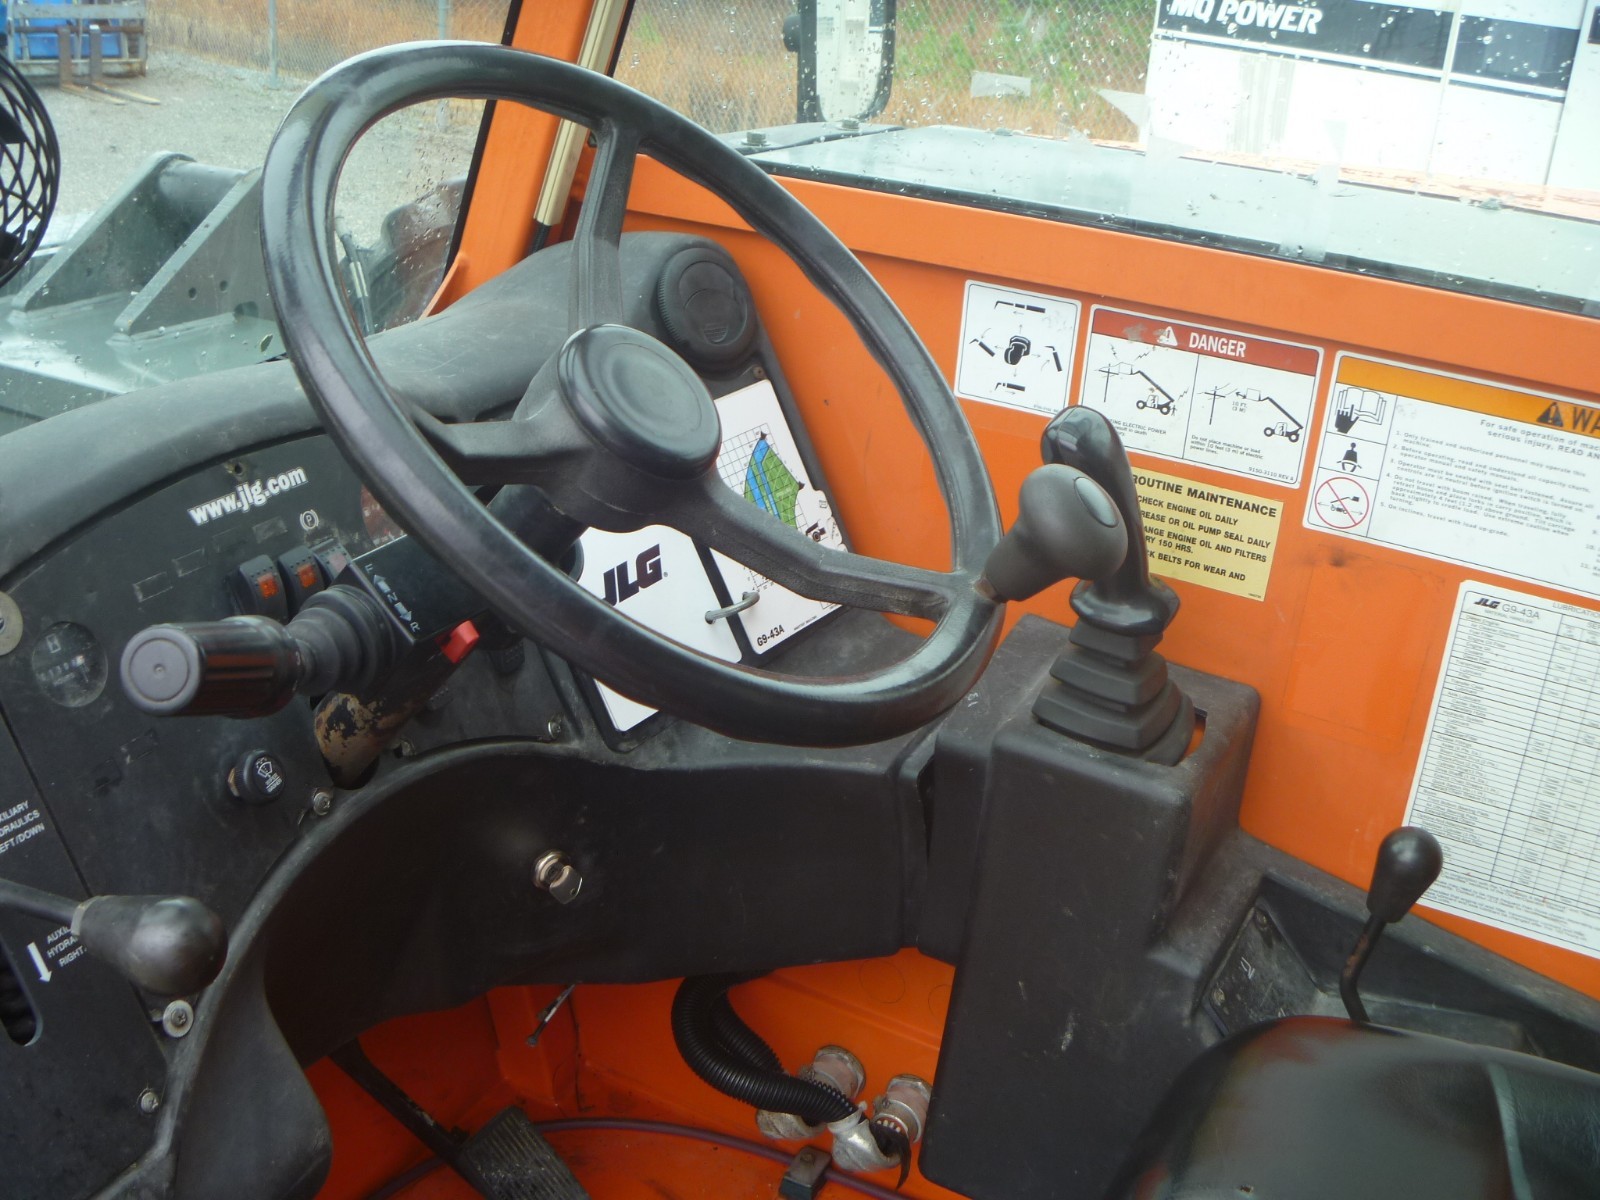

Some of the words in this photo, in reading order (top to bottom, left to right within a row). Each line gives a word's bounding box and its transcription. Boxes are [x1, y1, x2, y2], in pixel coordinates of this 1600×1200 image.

[1168, 0, 1214, 23] MQ
[1216, 0, 1323, 34] POWER
[1189, 332, 1246, 357] DANGER
[1123, 422, 1146, 430] ELECTRIC
[1480, 419, 1495, 428] For
[1499, 424, 1518, 433] safe
[1520, 428, 1565, 443] operation
[1568, 437, 1579, 445] of
[1487, 431, 1521, 442] serious
[1524, 437, 1554, 450] injury.
[1558, 445, 1584, 456] READ
[1586, 451, 1600, 459] AN
[188, 467, 308, 526] www.jlg.com
[1132, 475, 1182, 494] ROUTINE
[1187, 488, 1277, 517] MAINTENANCE
[1138, 495, 1164, 508] CHECK
[1167, 503, 1197, 515] ENGINE
[1200, 510, 1212, 519] OIL
[1215, 514, 1238, 526] DAILY
[1141, 511, 1166, 523] REASE
[1169, 517, 1180, 526] OR
[1183, 521, 1195, 530] OIL
[1199, 525, 1222, 535] PUMP
[1224, 531, 1244, 542] SEAL
[1248, 537, 1270, 549] DAILY
[1144, 526, 1165, 537] ANGE
[1167, 532, 1197, 544] ENGINE
[1200, 540, 1212, 549] OIL
[1215, 544, 1232, 554] AND
[1234, 549, 1267, 563] FILTERS
[1159, 539, 1172, 548] 150
[1175, 543, 1193, 554] HRS.
[601, 544, 662, 606] JLG
[1158, 553, 1182, 565] BELTS
[1184, 559, 1200, 570] FOR
[1203, 565, 1227, 577] WEAR
[1229, 571, 1246, 581] AND
[364, 563, 374, 574] F
[410, 621, 421, 633] R
[1474, 598, 1500, 609] JLG
[1502, 604, 1540, 619] G9-43A
[757, 624, 784, 646] G9-43A
[0, 801, 28, 822] XILIARY
[0, 810, 40, 837] DRAULICS
[0, 823, 45, 853] EFT/DOWN
[47, 926, 72, 944] AUXIL
[47, 936, 78, 958] HYDRA
[59, 946, 87, 967] RIGHT
